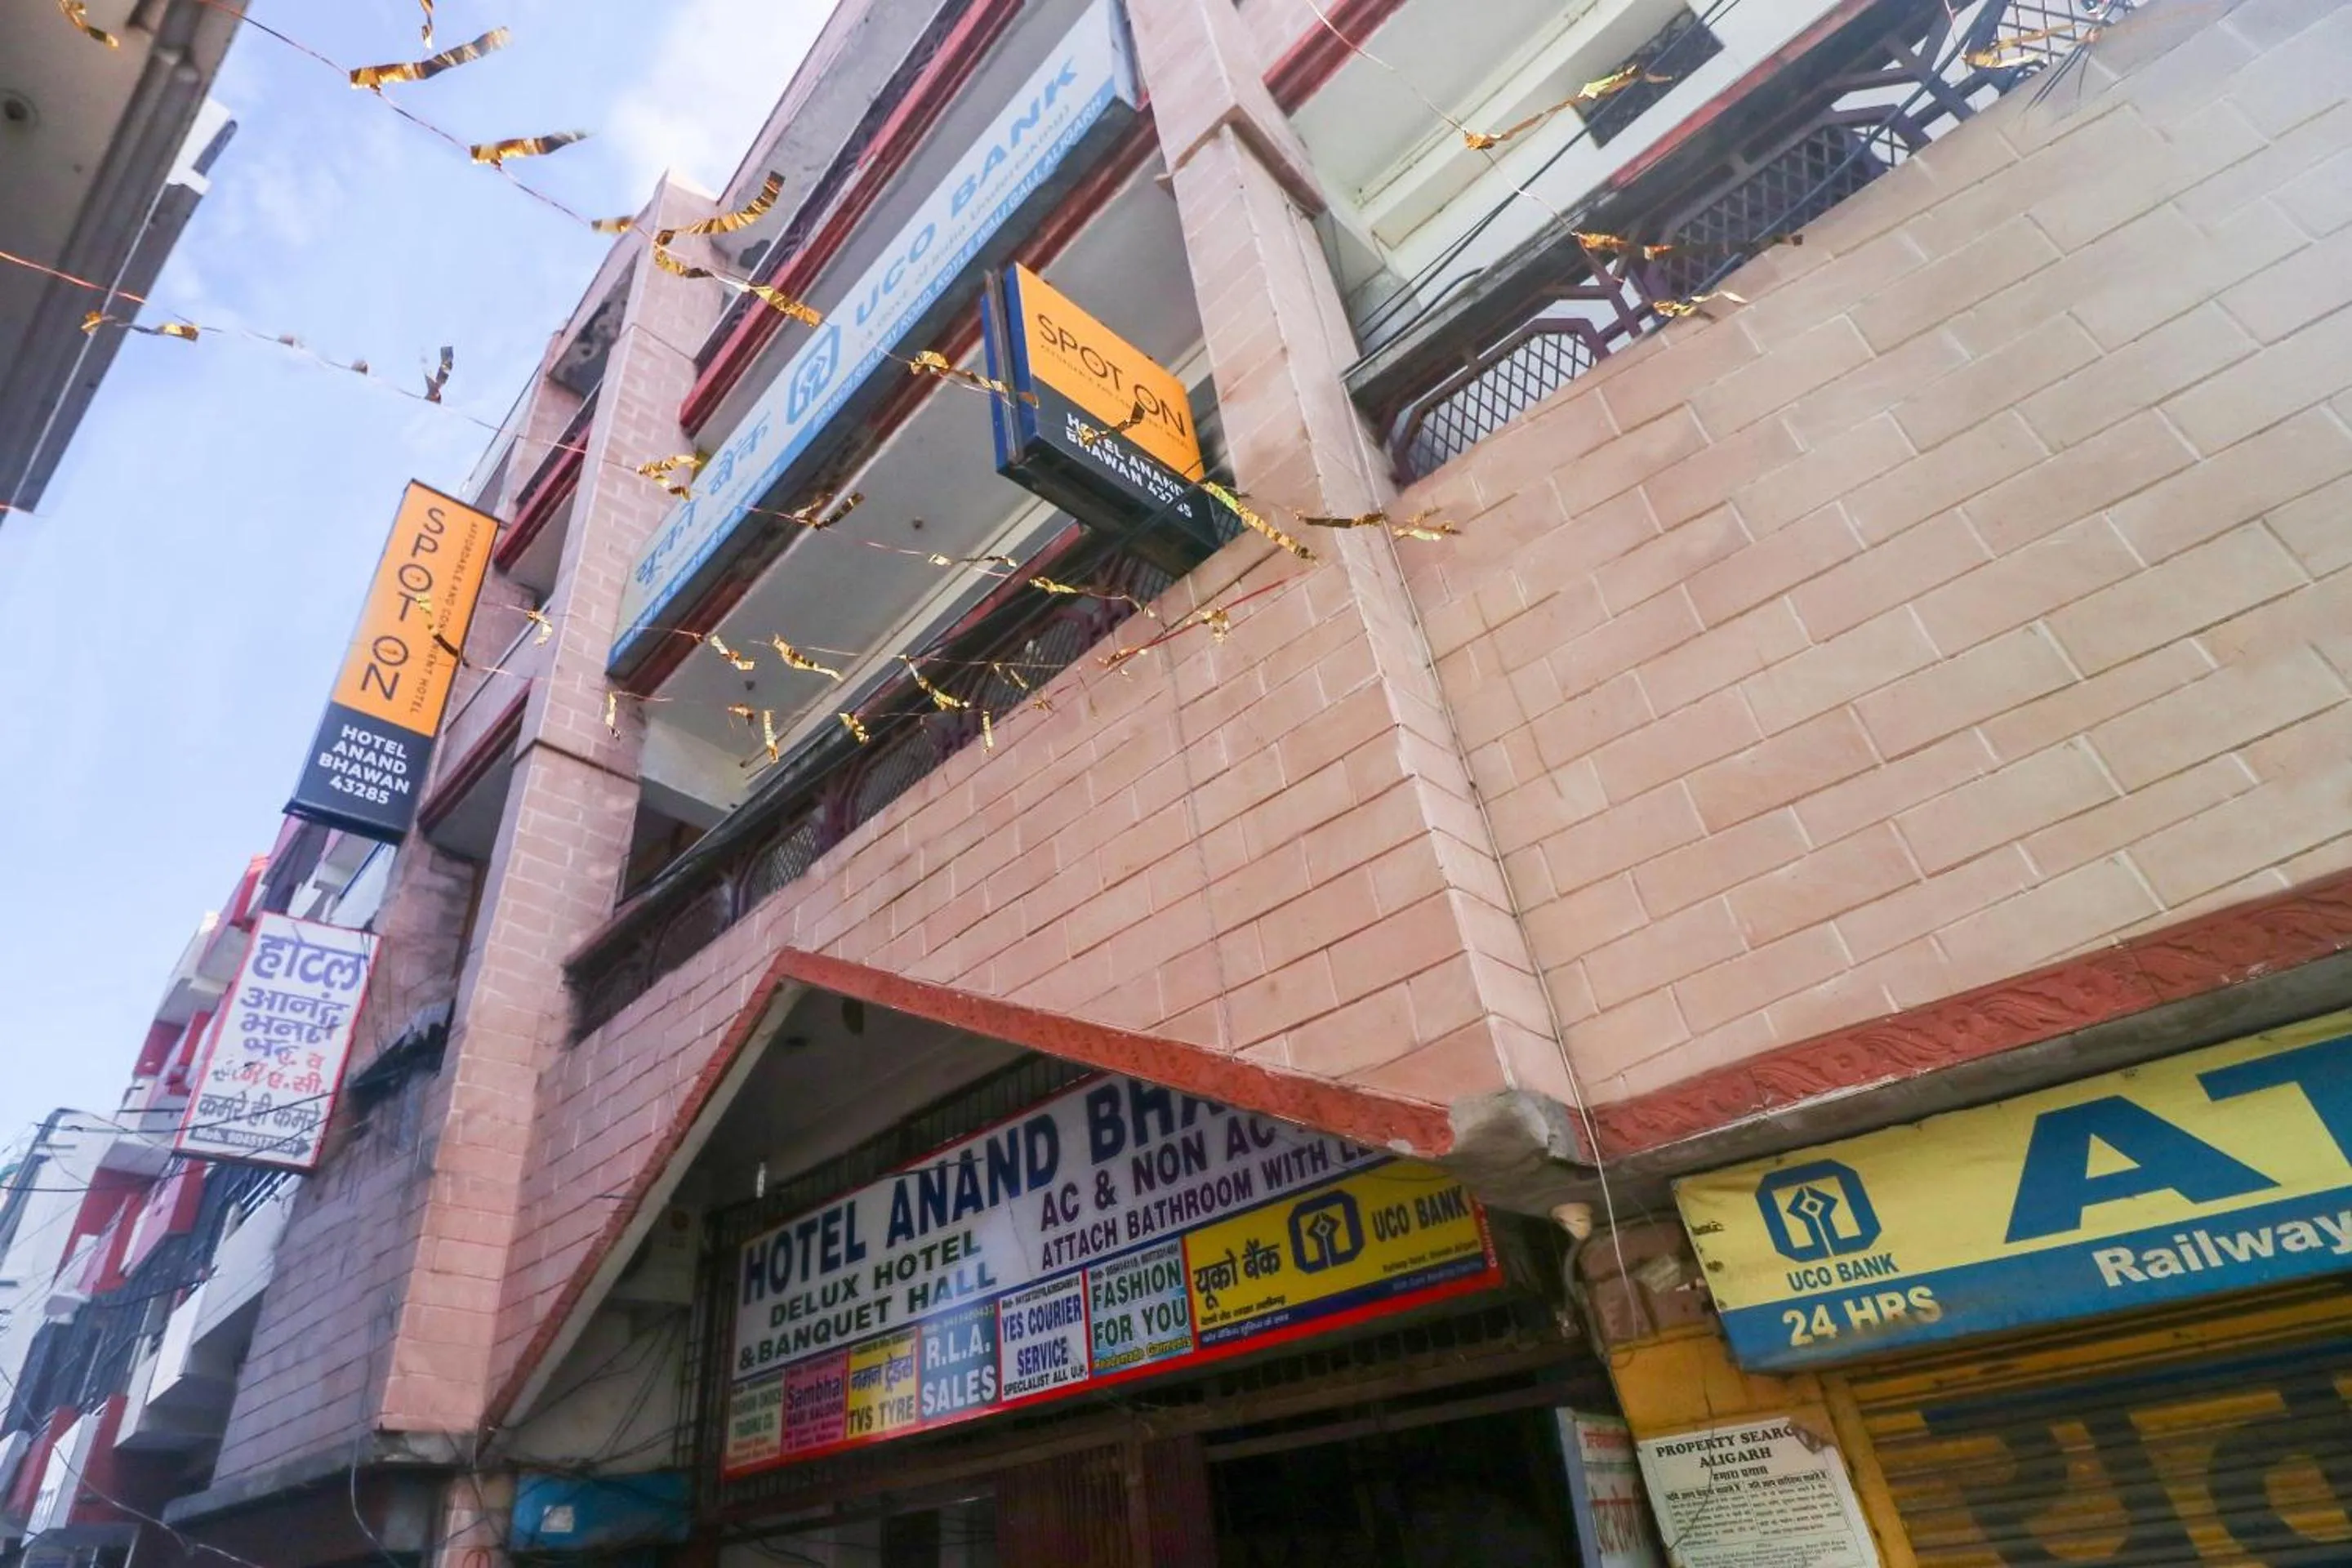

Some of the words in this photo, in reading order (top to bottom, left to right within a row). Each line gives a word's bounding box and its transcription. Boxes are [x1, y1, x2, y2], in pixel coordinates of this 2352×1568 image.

[857, 221, 936, 327] UCO
[951, 56, 1078, 220] BANK
[1038, 313, 1123, 391] SPOT
[1134, 384, 1187, 437] ON
[1067, 412, 1125, 460] HTEL
[1129, 455, 1184, 497] ANAND
[398, 506, 446, 622] SPOT
[425, 604, 452, 677] CONNIENT
[360, 635, 409, 702] ON
[410, 679, 431, 714] HOTEL
[332, 740, 407, 775] ANAND
[341, 724, 408, 760] HOTEL
[318, 752, 410, 795] BHAWAN
[329, 775, 390, 805] 43285
[1040, 1181, 1080, 1232] AC
[1094, 1169, 1118, 1208] &
[1132, 1129, 1208, 1196] NON
[1227, 1116, 1276, 1161] AC
[744, 1200, 866, 1305] HOTEL
[887, 1112, 1060, 1248] ANAND
[1042, 1222, 1120, 1271] ATTACH
[1128, 1168, 1254, 1239] BATHROOM
[1262, 1136, 1330, 1190] WITH
[1371, 1203, 1410, 1242] UCO
[1414, 1185, 1470, 1230] BANK
[1193, 1248, 1239, 1310] यूको
[1241, 1238, 1281, 1280] बैंक
[1787, 1267, 1834, 1292] UCO
[1838, 1253, 1900, 1285] BANK
[2092, 1207, 2352, 1290] Railway
[769, 1274, 859, 1329] DELUX
[874, 1229, 982, 1290] HOTEL
[908, 1261, 998, 1313] HALL
[1091, 1258, 1183, 1312] FASHION
[1001, 1311, 1024, 1343] YES
[1028, 1293, 1083, 1336] COURIER
[1094, 1313, 1134, 1350] FOR
[1141, 1296, 1187, 1336] YOU
[1782, 1306, 1838, 1347] 24
[1842, 1286, 1944, 1338] HRS
[925, 1323, 991, 1370] R.L.A.
[1016, 1336, 1069, 1377] SERVICE
[921, 1364, 997, 1417] SALES
[1053, 1369, 1069, 1383] ALL
[849, 1405, 875, 1435] TVS
[879, 1394, 915, 1427] TYRE
[1656, 1433, 1736, 1458] PROPERTY
[1699, 1446, 1773, 1469] ALIGARH
